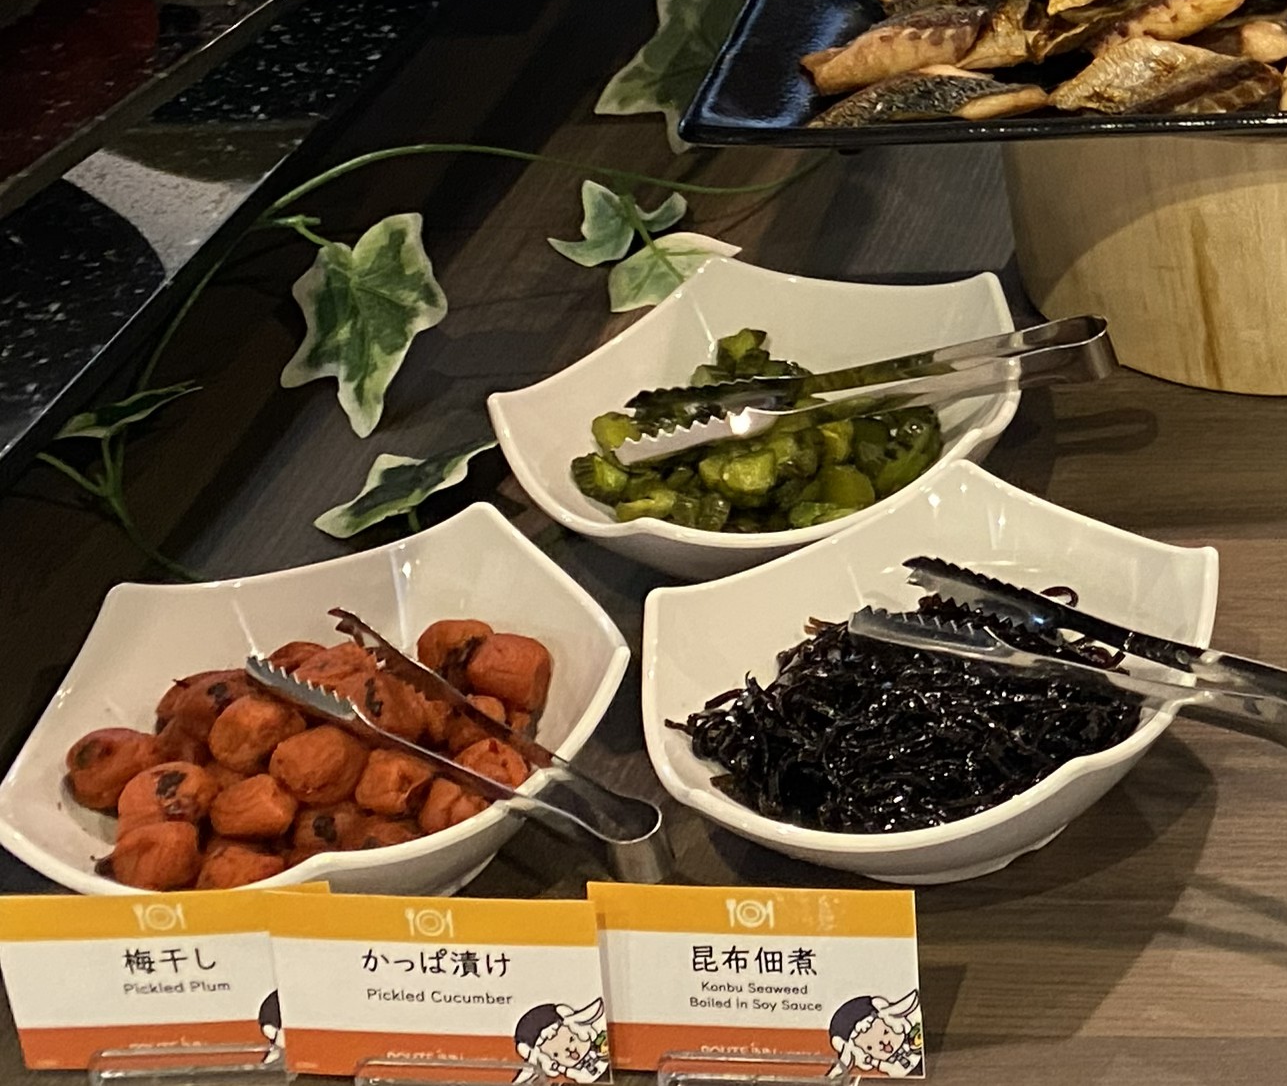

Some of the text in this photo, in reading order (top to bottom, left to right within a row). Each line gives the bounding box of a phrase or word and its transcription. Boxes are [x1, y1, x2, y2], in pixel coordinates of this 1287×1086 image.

[122, 947, 217, 975] 梅干し
[361, 947, 512, 978] かっぱ漬け
[692, 944, 819, 976] 昆布佃煮
[123, 980, 231, 995] Pickled Plum
[701, 981, 808, 995] Konbu Seaweed
[366, 988, 513, 1005] Pickled Cucumber
[689, 996, 823, 1013] Boiled in Soy Sauce
